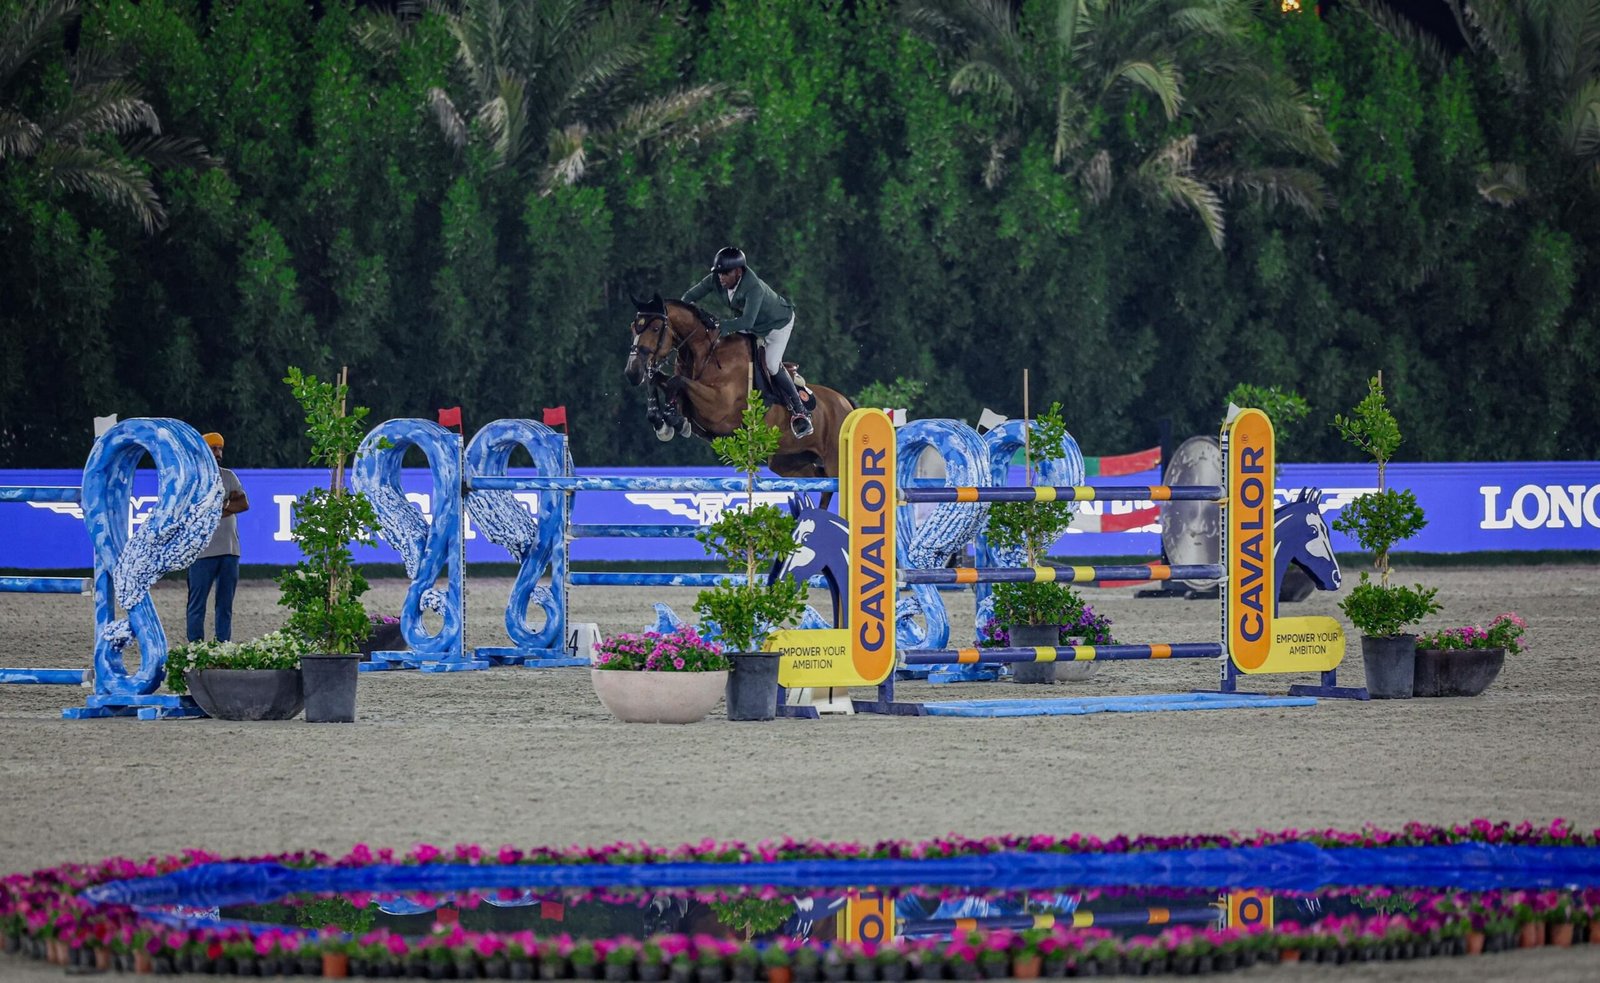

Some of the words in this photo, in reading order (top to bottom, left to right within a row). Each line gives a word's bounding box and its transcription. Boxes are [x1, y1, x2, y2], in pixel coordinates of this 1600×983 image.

[568, 629, 579, 657] 4
[1276, 634, 1316, 644] EMPOWER
[1316, 632, 1339, 643] YOUR
[822, 646, 846, 656] YOUR
[1289, 645, 1327, 655] AMBITION
[792, 659, 833, 670] AMBITION
